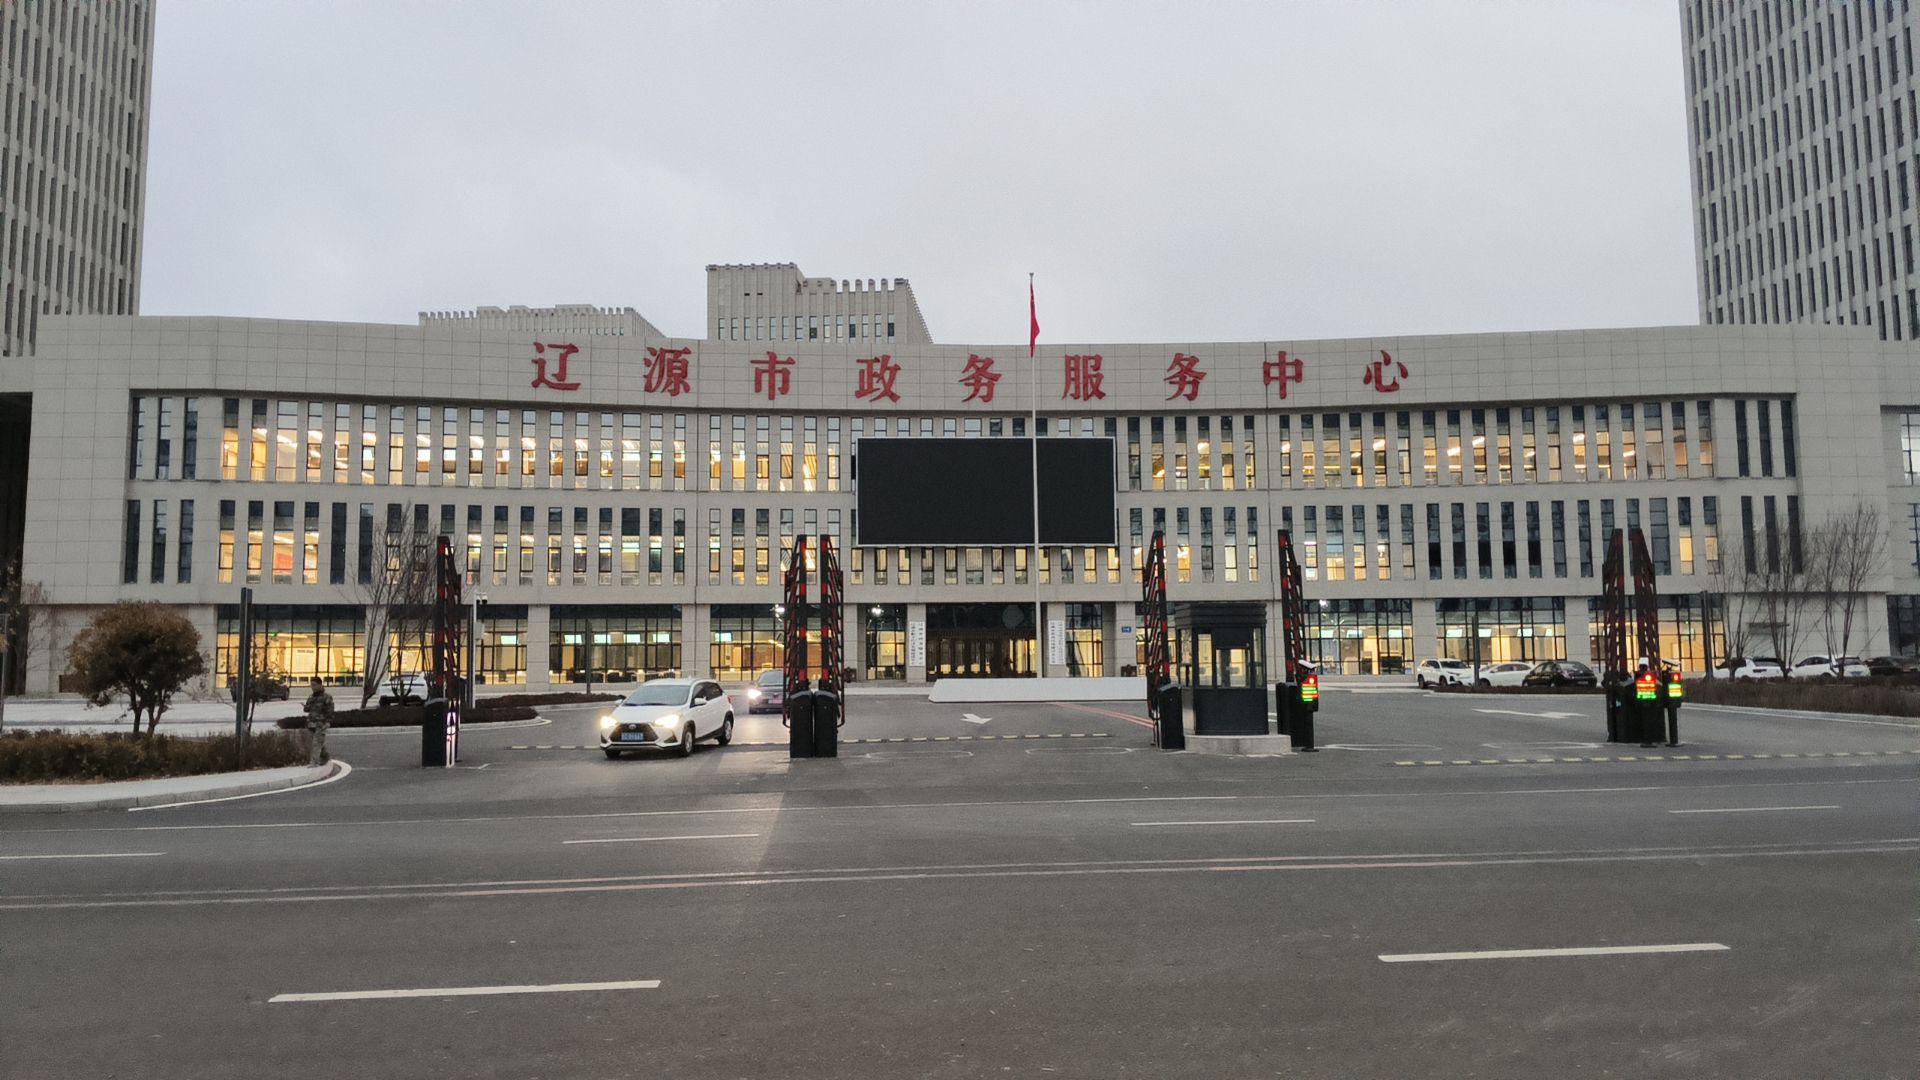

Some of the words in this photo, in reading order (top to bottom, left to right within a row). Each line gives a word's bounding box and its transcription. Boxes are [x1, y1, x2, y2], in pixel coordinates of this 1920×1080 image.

[531, 343, 1409, 402] 辽源市政务服务中心
